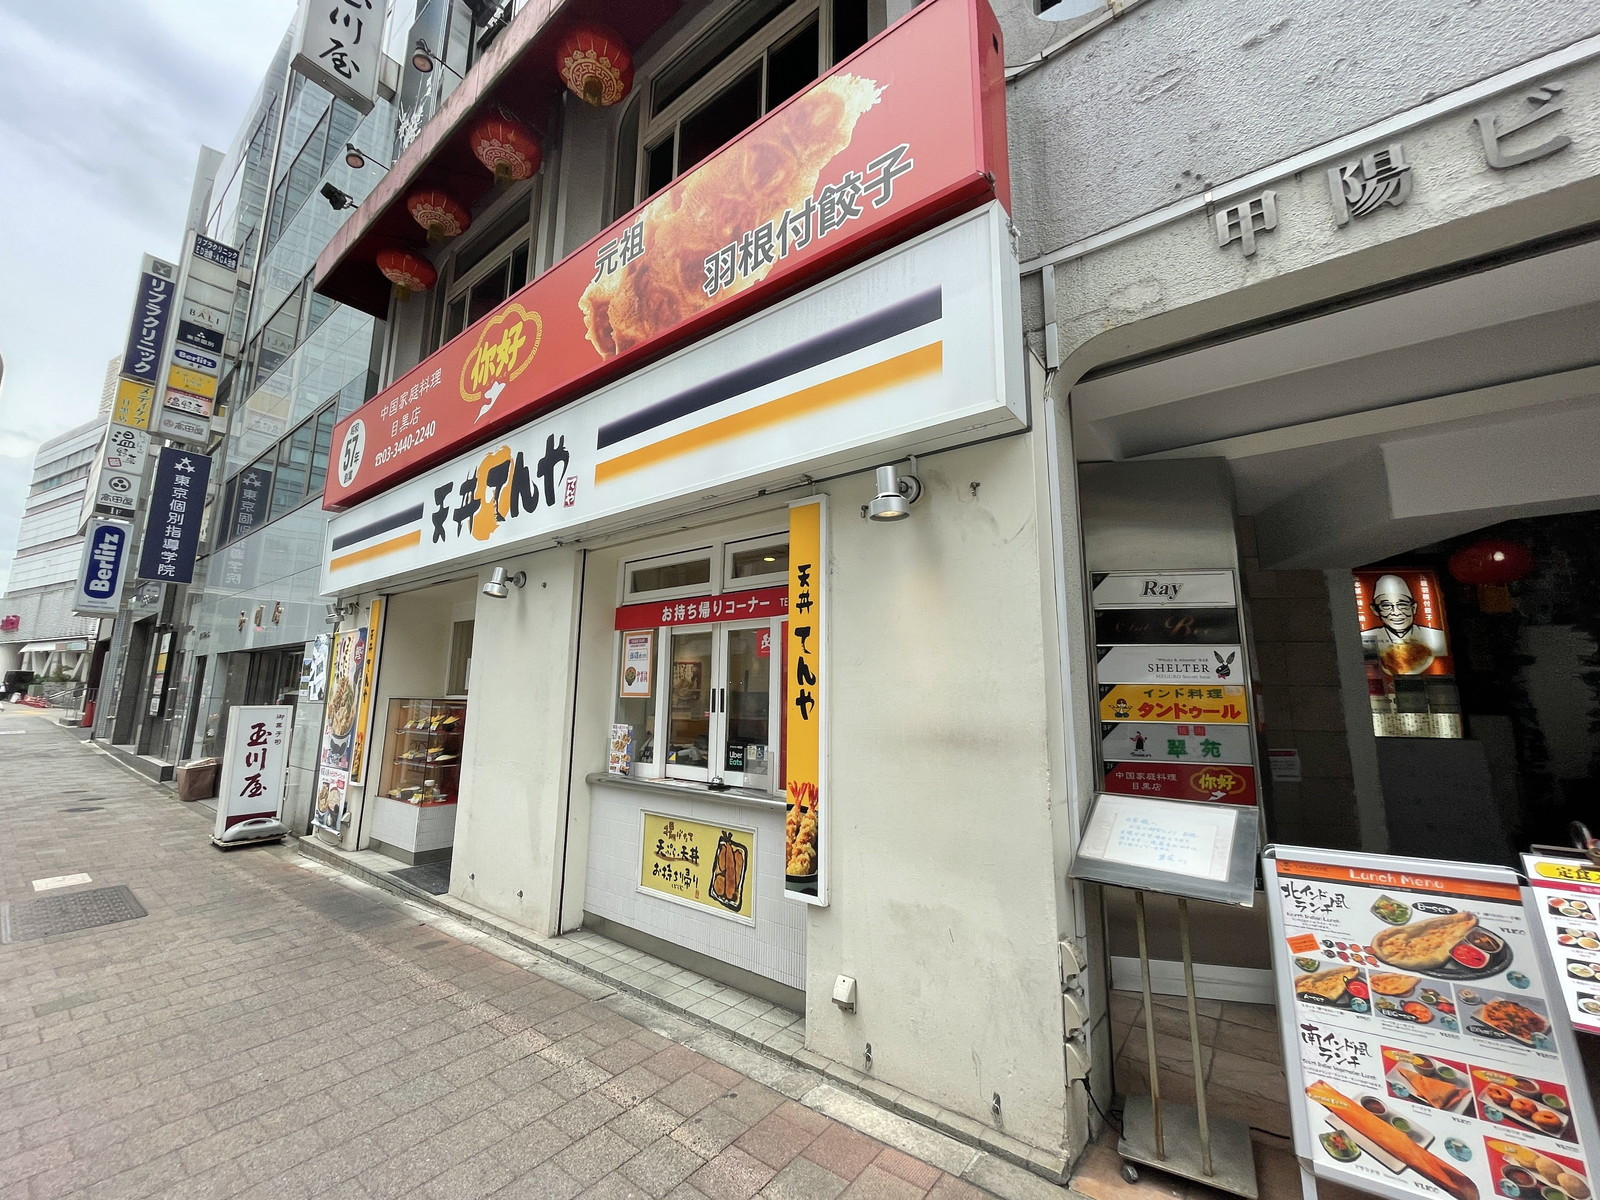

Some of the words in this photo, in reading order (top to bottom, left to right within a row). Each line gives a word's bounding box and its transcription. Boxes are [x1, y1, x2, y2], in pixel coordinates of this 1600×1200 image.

[319, 0, 372, 79] 川屋
[703, 143, 914, 297] 羽根付餃子
[594, 221, 646, 284] 元祖
[189, 308, 220, 325] BALI
[178, 351, 213, 367] Berlitz
[471, 321, 526, 391] 你好
[380, 367, 442, 421] 中国家庭料理
[391, 406, 421, 438] 目黒店
[157, 473, 191, 577] 東京個別指導学院
[89, 532, 120, 592] Berlitz
[1141, 579, 1183, 600] Ray
[661, 596, 770, 622] お持ち帰りコーナー
[794, 626, 816, 720] てんや
[1147, 663, 1210, 673] SHELTER
[1143, 687, 1223, 700] インド料理
[1137, 701, 1242, 720] タンドゥール
[239, 722, 272, 798] 玉川屋
[729, 758, 743, 766] Eats
[730, 751, 743, 759] Uber
[1115, 771, 1177, 781] 中国家庭料理
[1199, 773, 1236, 791] 你好
[1349, 868, 1396, 884] Lunch
[1400, 874, 1445, 889] Menu
[1556, 866, 1600, 881] 定食
[1295, 899, 1333, 914] ランチ
[1319, 1046, 1361, 1068] ランチ
